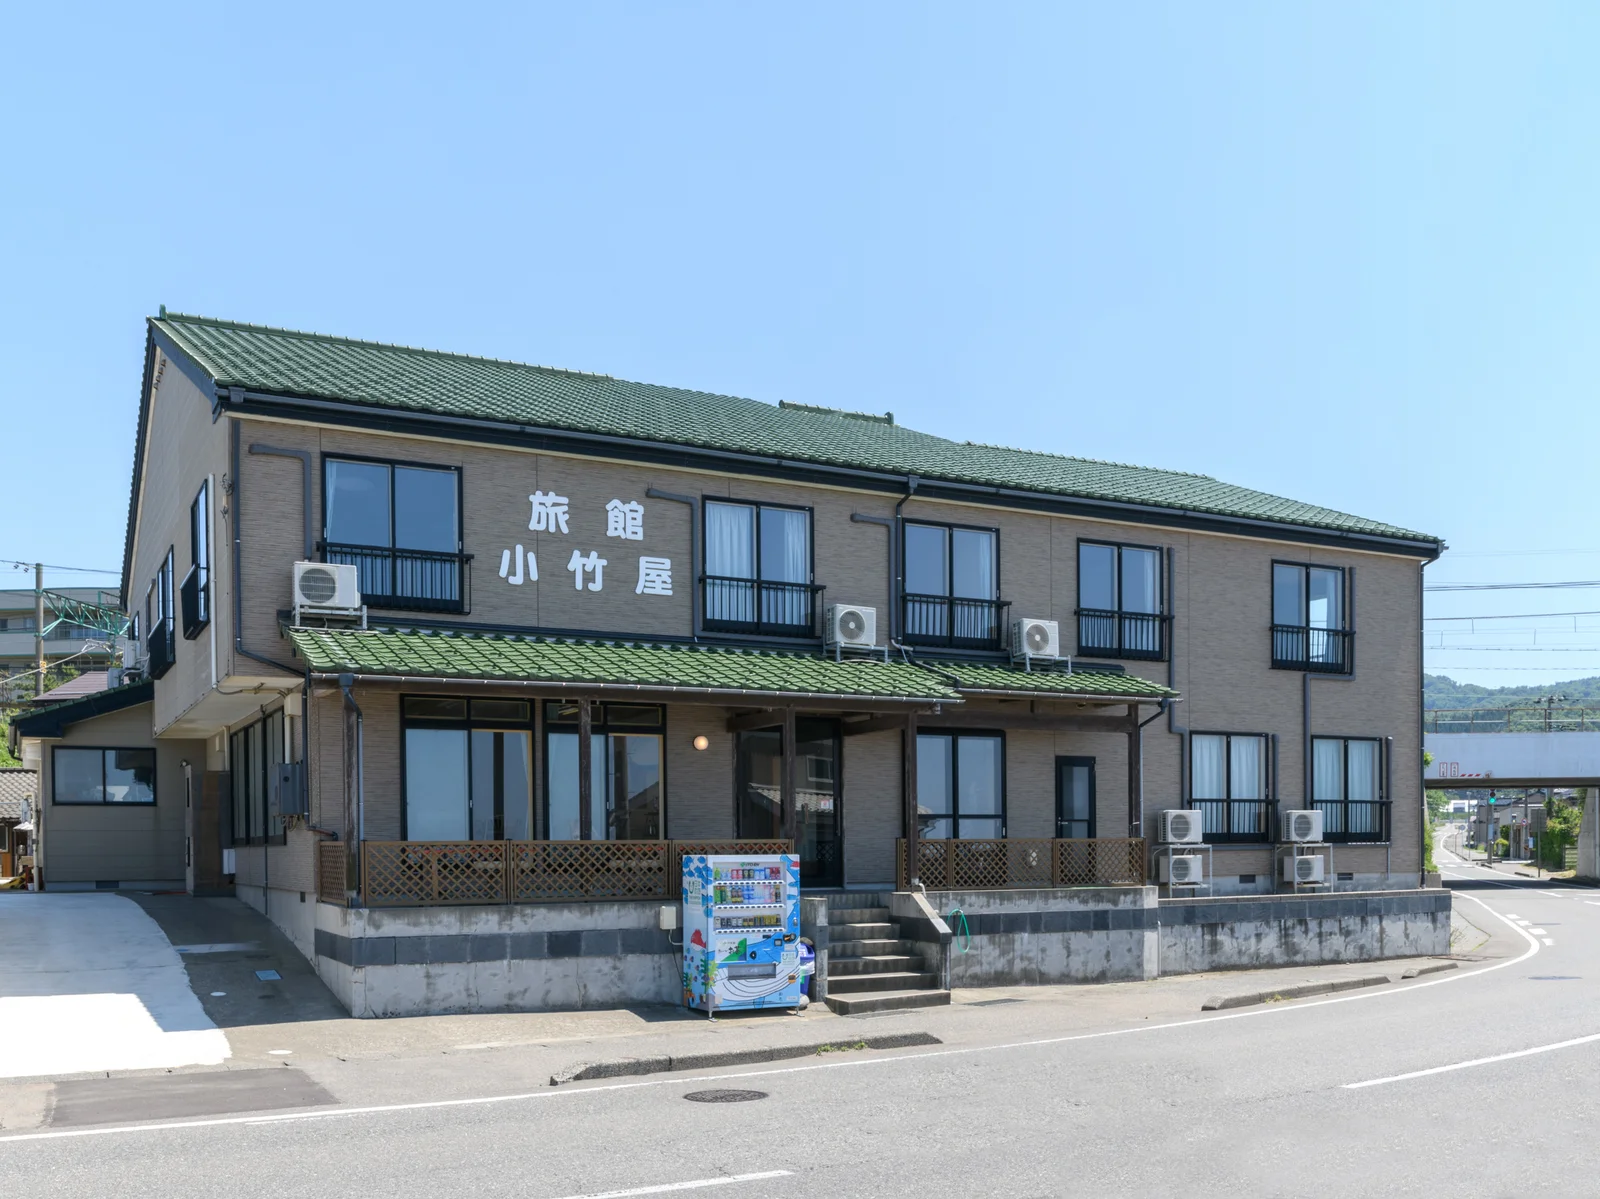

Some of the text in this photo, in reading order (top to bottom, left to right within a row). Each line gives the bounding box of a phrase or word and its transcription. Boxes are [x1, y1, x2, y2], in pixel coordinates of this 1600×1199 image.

[528, 490, 645, 541] 旅館
[498, 544, 673, 596] 小竹屋
